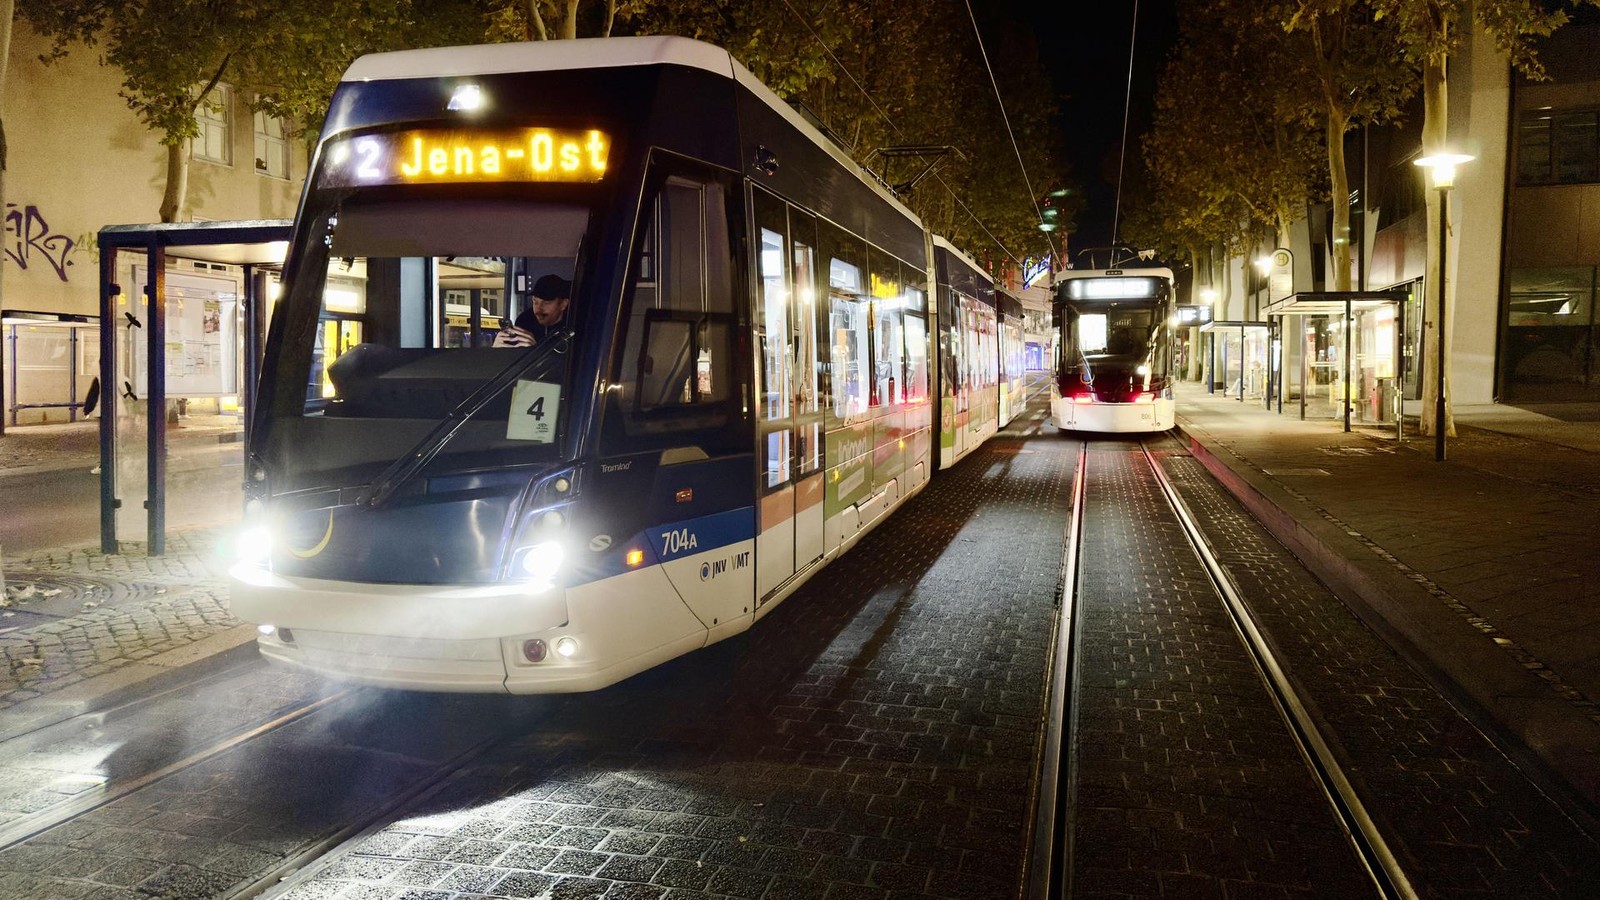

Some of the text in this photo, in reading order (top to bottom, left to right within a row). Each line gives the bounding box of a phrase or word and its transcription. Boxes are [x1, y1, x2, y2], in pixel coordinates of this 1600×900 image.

[357, 130, 607, 178] 2 Jena-Ost
[526, 396, 545, 421] 4
[661, 527, 698, 556] 704A
